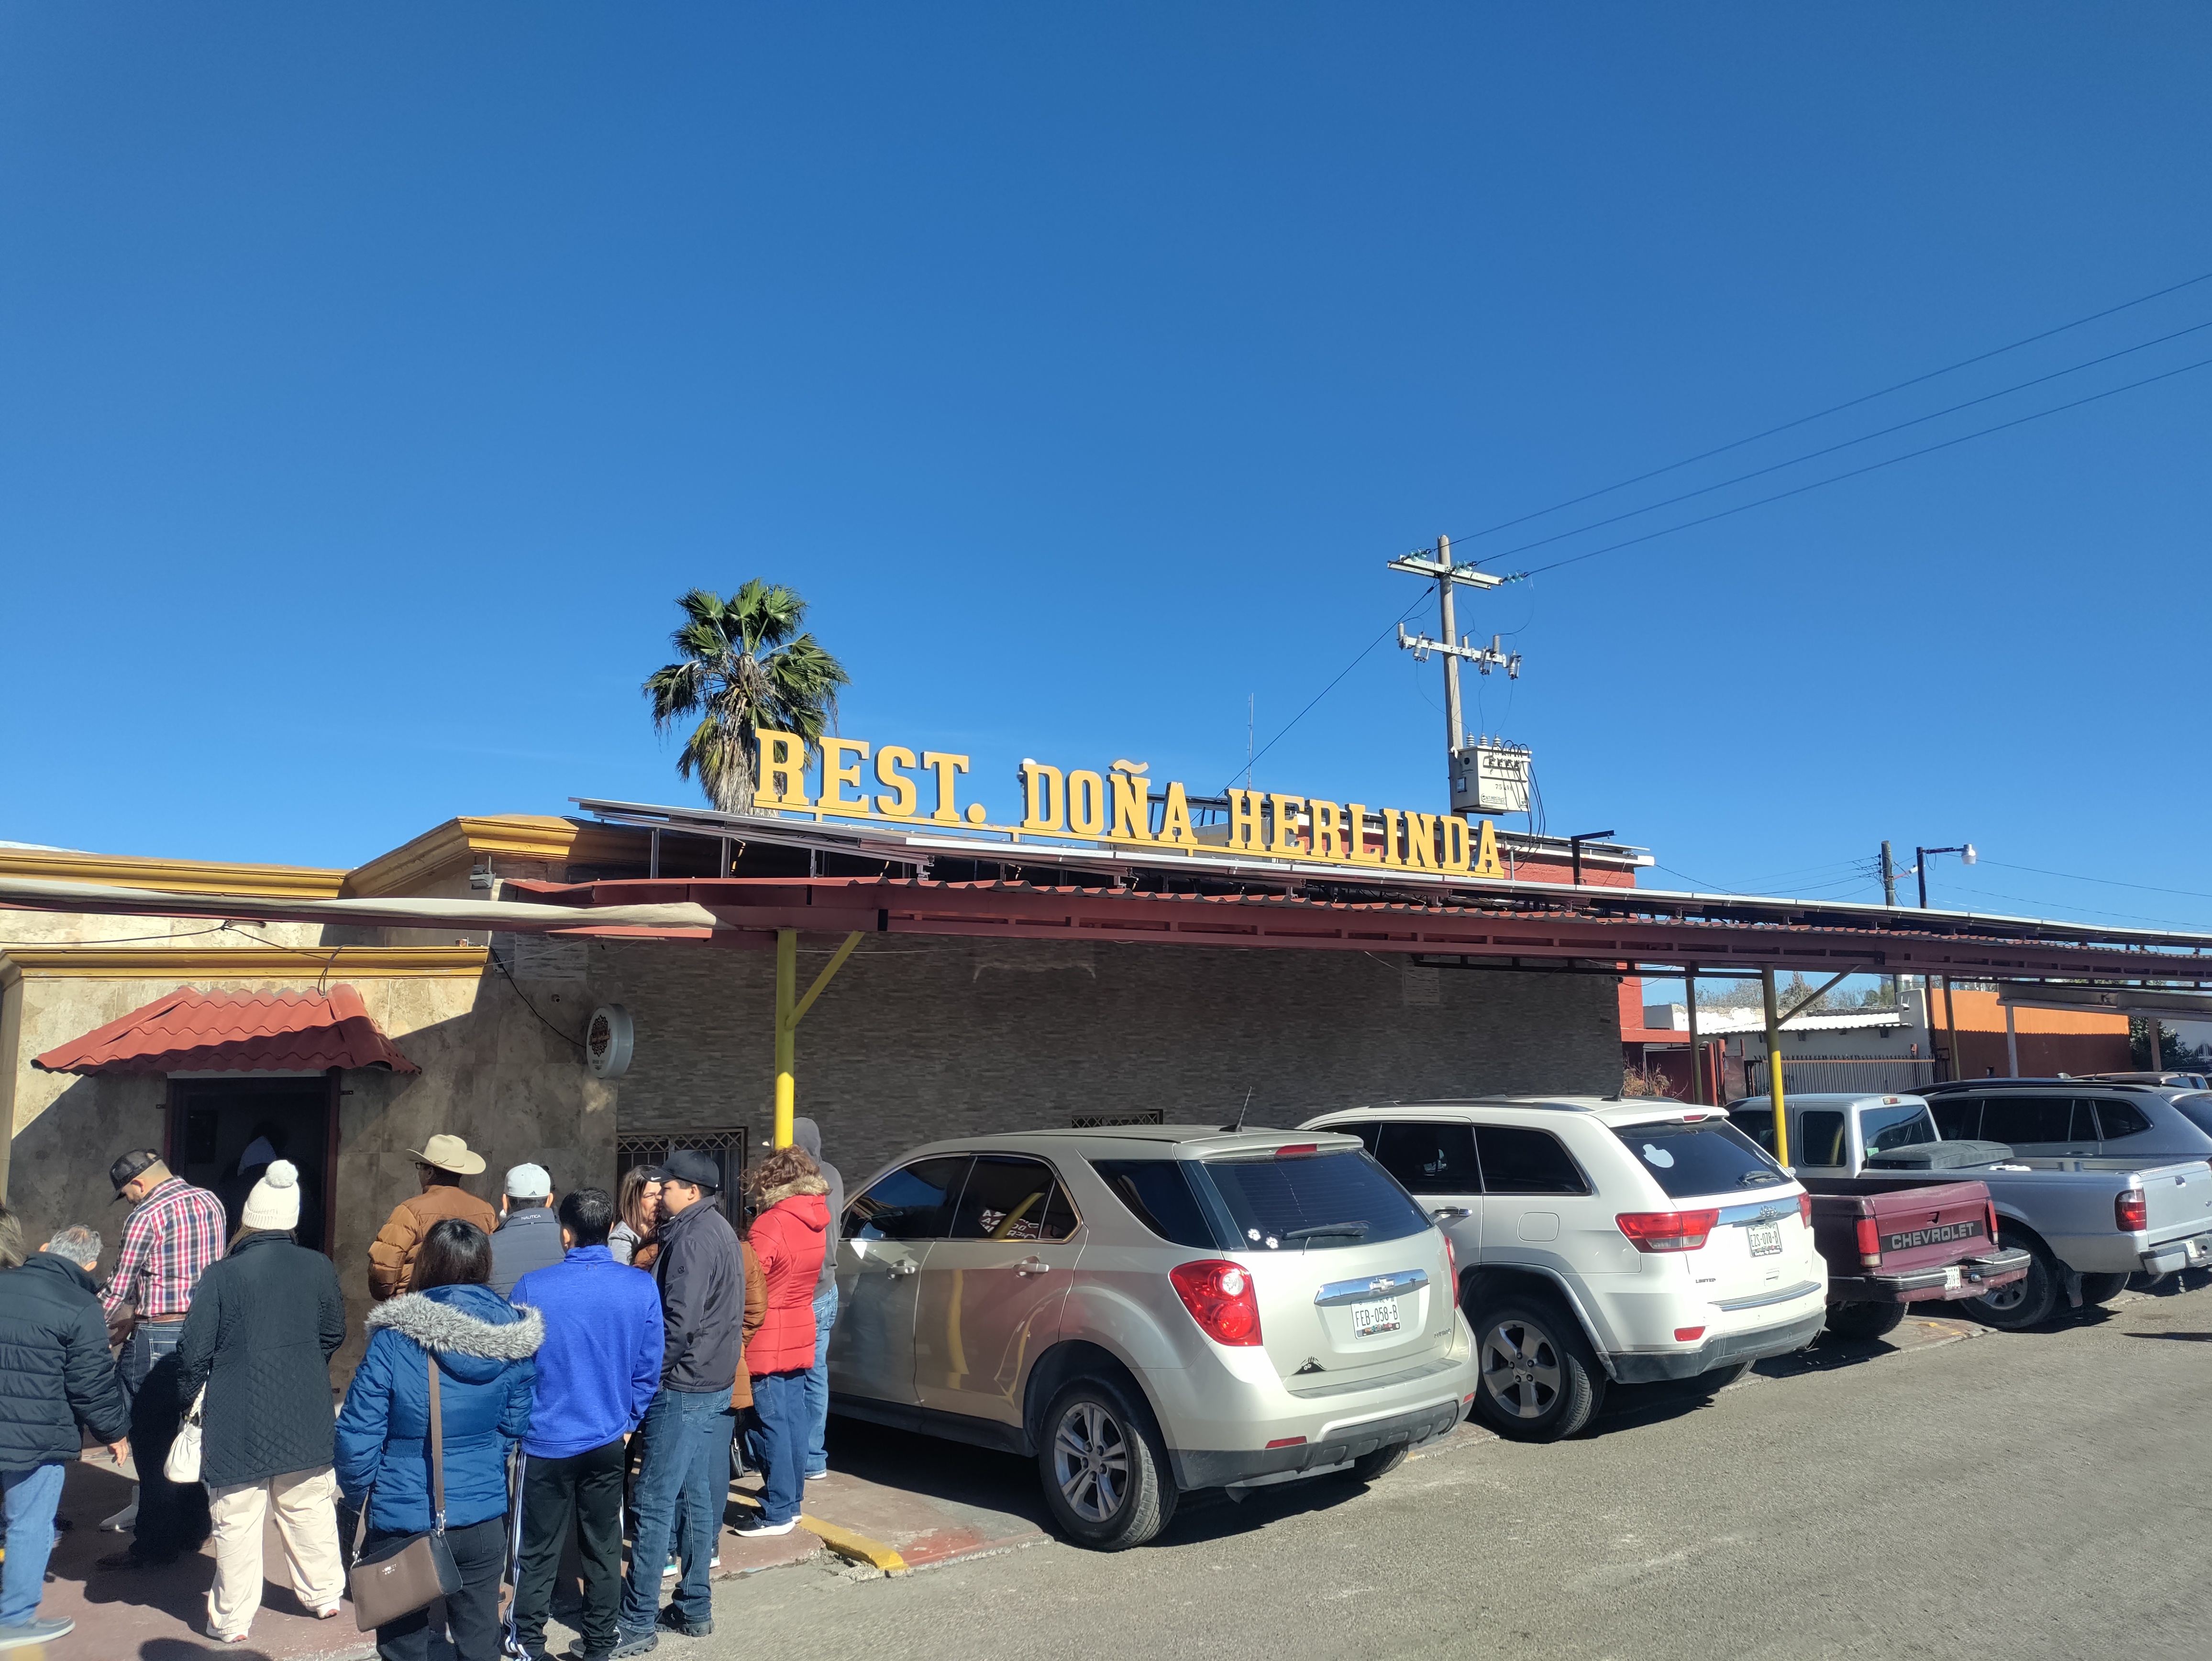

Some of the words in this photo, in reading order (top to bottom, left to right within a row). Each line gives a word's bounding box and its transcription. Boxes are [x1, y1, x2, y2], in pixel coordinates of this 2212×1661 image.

[753, 728, 986, 824] REST.
[1021, 759, 1197, 844] DOÑA
[1225, 788, 1504, 874] HERLINDA
[1750, 1230, 1778, 1247] EZS-078-B
[1891, 1222, 1974, 1249] CHEVROLET
[1355, 1305, 1398, 1327] FEB-058-B
